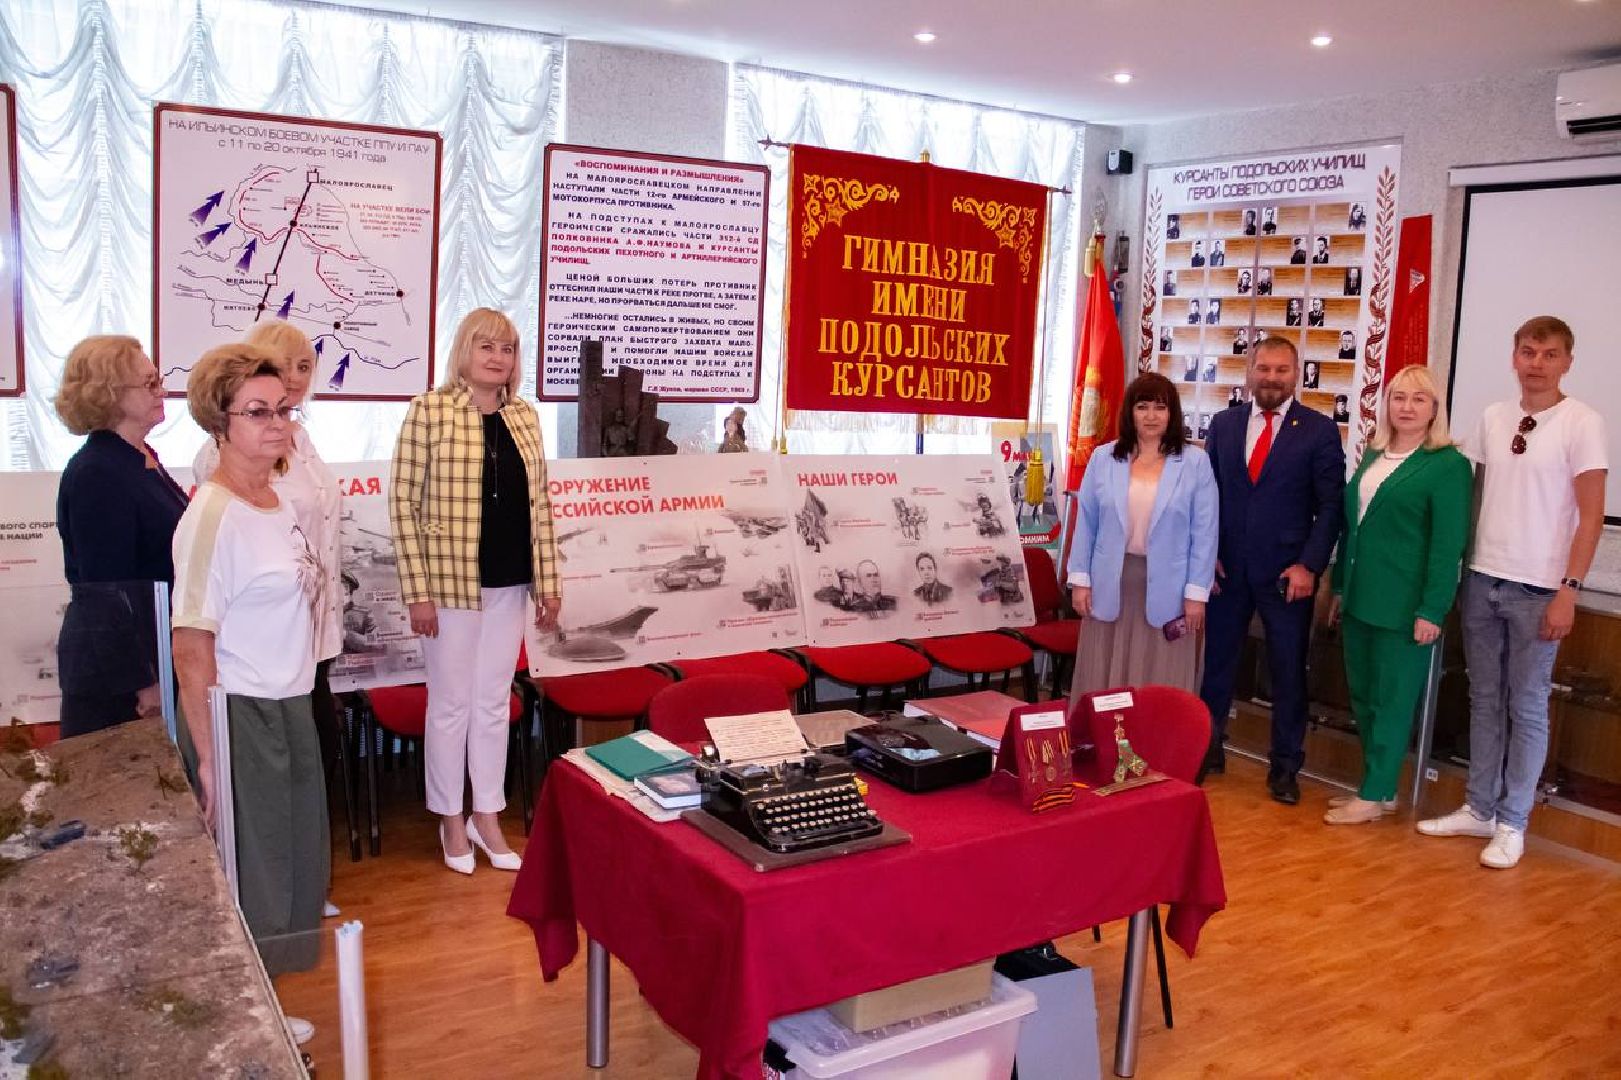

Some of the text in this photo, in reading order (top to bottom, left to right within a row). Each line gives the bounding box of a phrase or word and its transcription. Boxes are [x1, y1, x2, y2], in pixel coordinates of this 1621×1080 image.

[168, 120, 186, 130] НА
[269, 129, 318, 142] БОЕВОМ
[320, 134, 373, 150] УЧАСТКЕ
[398, 142, 406, 151] И
[230, 139, 243, 150] 11
[264, 141, 280, 152] 20
[282, 146, 326, 156] октября
[331, 148, 358, 160] 1941
[362, 154, 386, 162] года
[1173, 167, 1229, 184] КУРСАНТЫ
[1231, 159, 1308, 180] ПОДОЛЬСКИХ
[553, 182, 605, 192] НАСТУПАЛИ
[612, 188, 640, 196] ЧАСТИ
[672, 193, 725, 204] АРМЕЙСКОГО
[1187, 175, 1344, 202] ГЕРОИ СОВЕТСКОГО СОЮЗА
[553, 194, 616, 206] МОТОКОРПУСА
[591, 213, 653, 225] ПОДСТУПАХ
[552, 222, 613, 232] ГЕРОИЧЕСКИ
[620, 227, 676, 238] СРАЖАЛИСЬ
[683, 232, 712, 240] ЧАСТИ
[552, 234, 619, 244] ПОЛКОВНИКА
[711, 244, 758, 254] КУРСАНТЫ
[552, 245, 610, 254] ПОДОЛЬСКИХ
[616, 248, 665, 258] ПЕХОТНОГО
[842, 235, 995, 286] ГИМНАЗИЯ
[549, 284, 596, 292] ОТТЕСНИЛ
[662, 289, 680, 297] РЕКЕ
[566, 274, 757, 290] ЦЕНОЙ БОЛЬШИХ ПОТЕРЬ ПРОТИВНИК
[871, 280, 967, 322] ИМЕНИ
[548, 323, 615, 331] ГЕРОИЧЕСКИМ
[623, 314, 666, 322] ОСТАЛИСЬ
[818, 319, 1010, 366] ПОДОЛЬСКИХ
[830, 362, 992, 403] КУРСАНТОВ
[1001, 440, 1011, 462] 9
[549, 476, 650, 495] ОРУЖЕНИЕ
[798, 473, 897, 486] НАШИ ГЕРОИ
[553, 496, 725, 517] ССИЙСКОЙ АРМИИ
